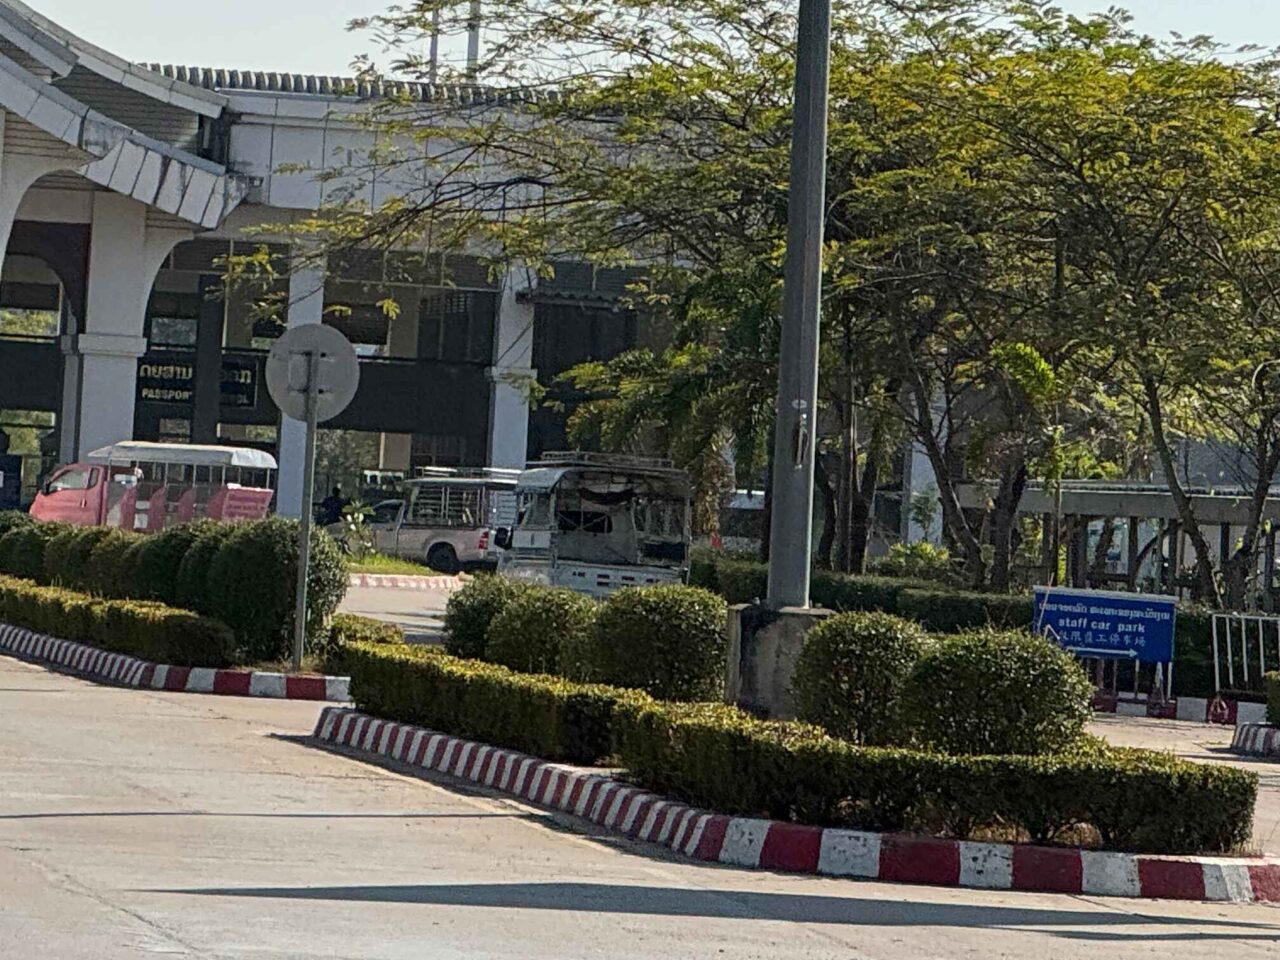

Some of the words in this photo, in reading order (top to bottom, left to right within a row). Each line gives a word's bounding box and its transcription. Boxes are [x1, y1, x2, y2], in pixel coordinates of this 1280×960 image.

[1058, 617, 1088, 629] staff
[1091, 621, 1111, 630] car
[1117, 623, 1146, 633] park
